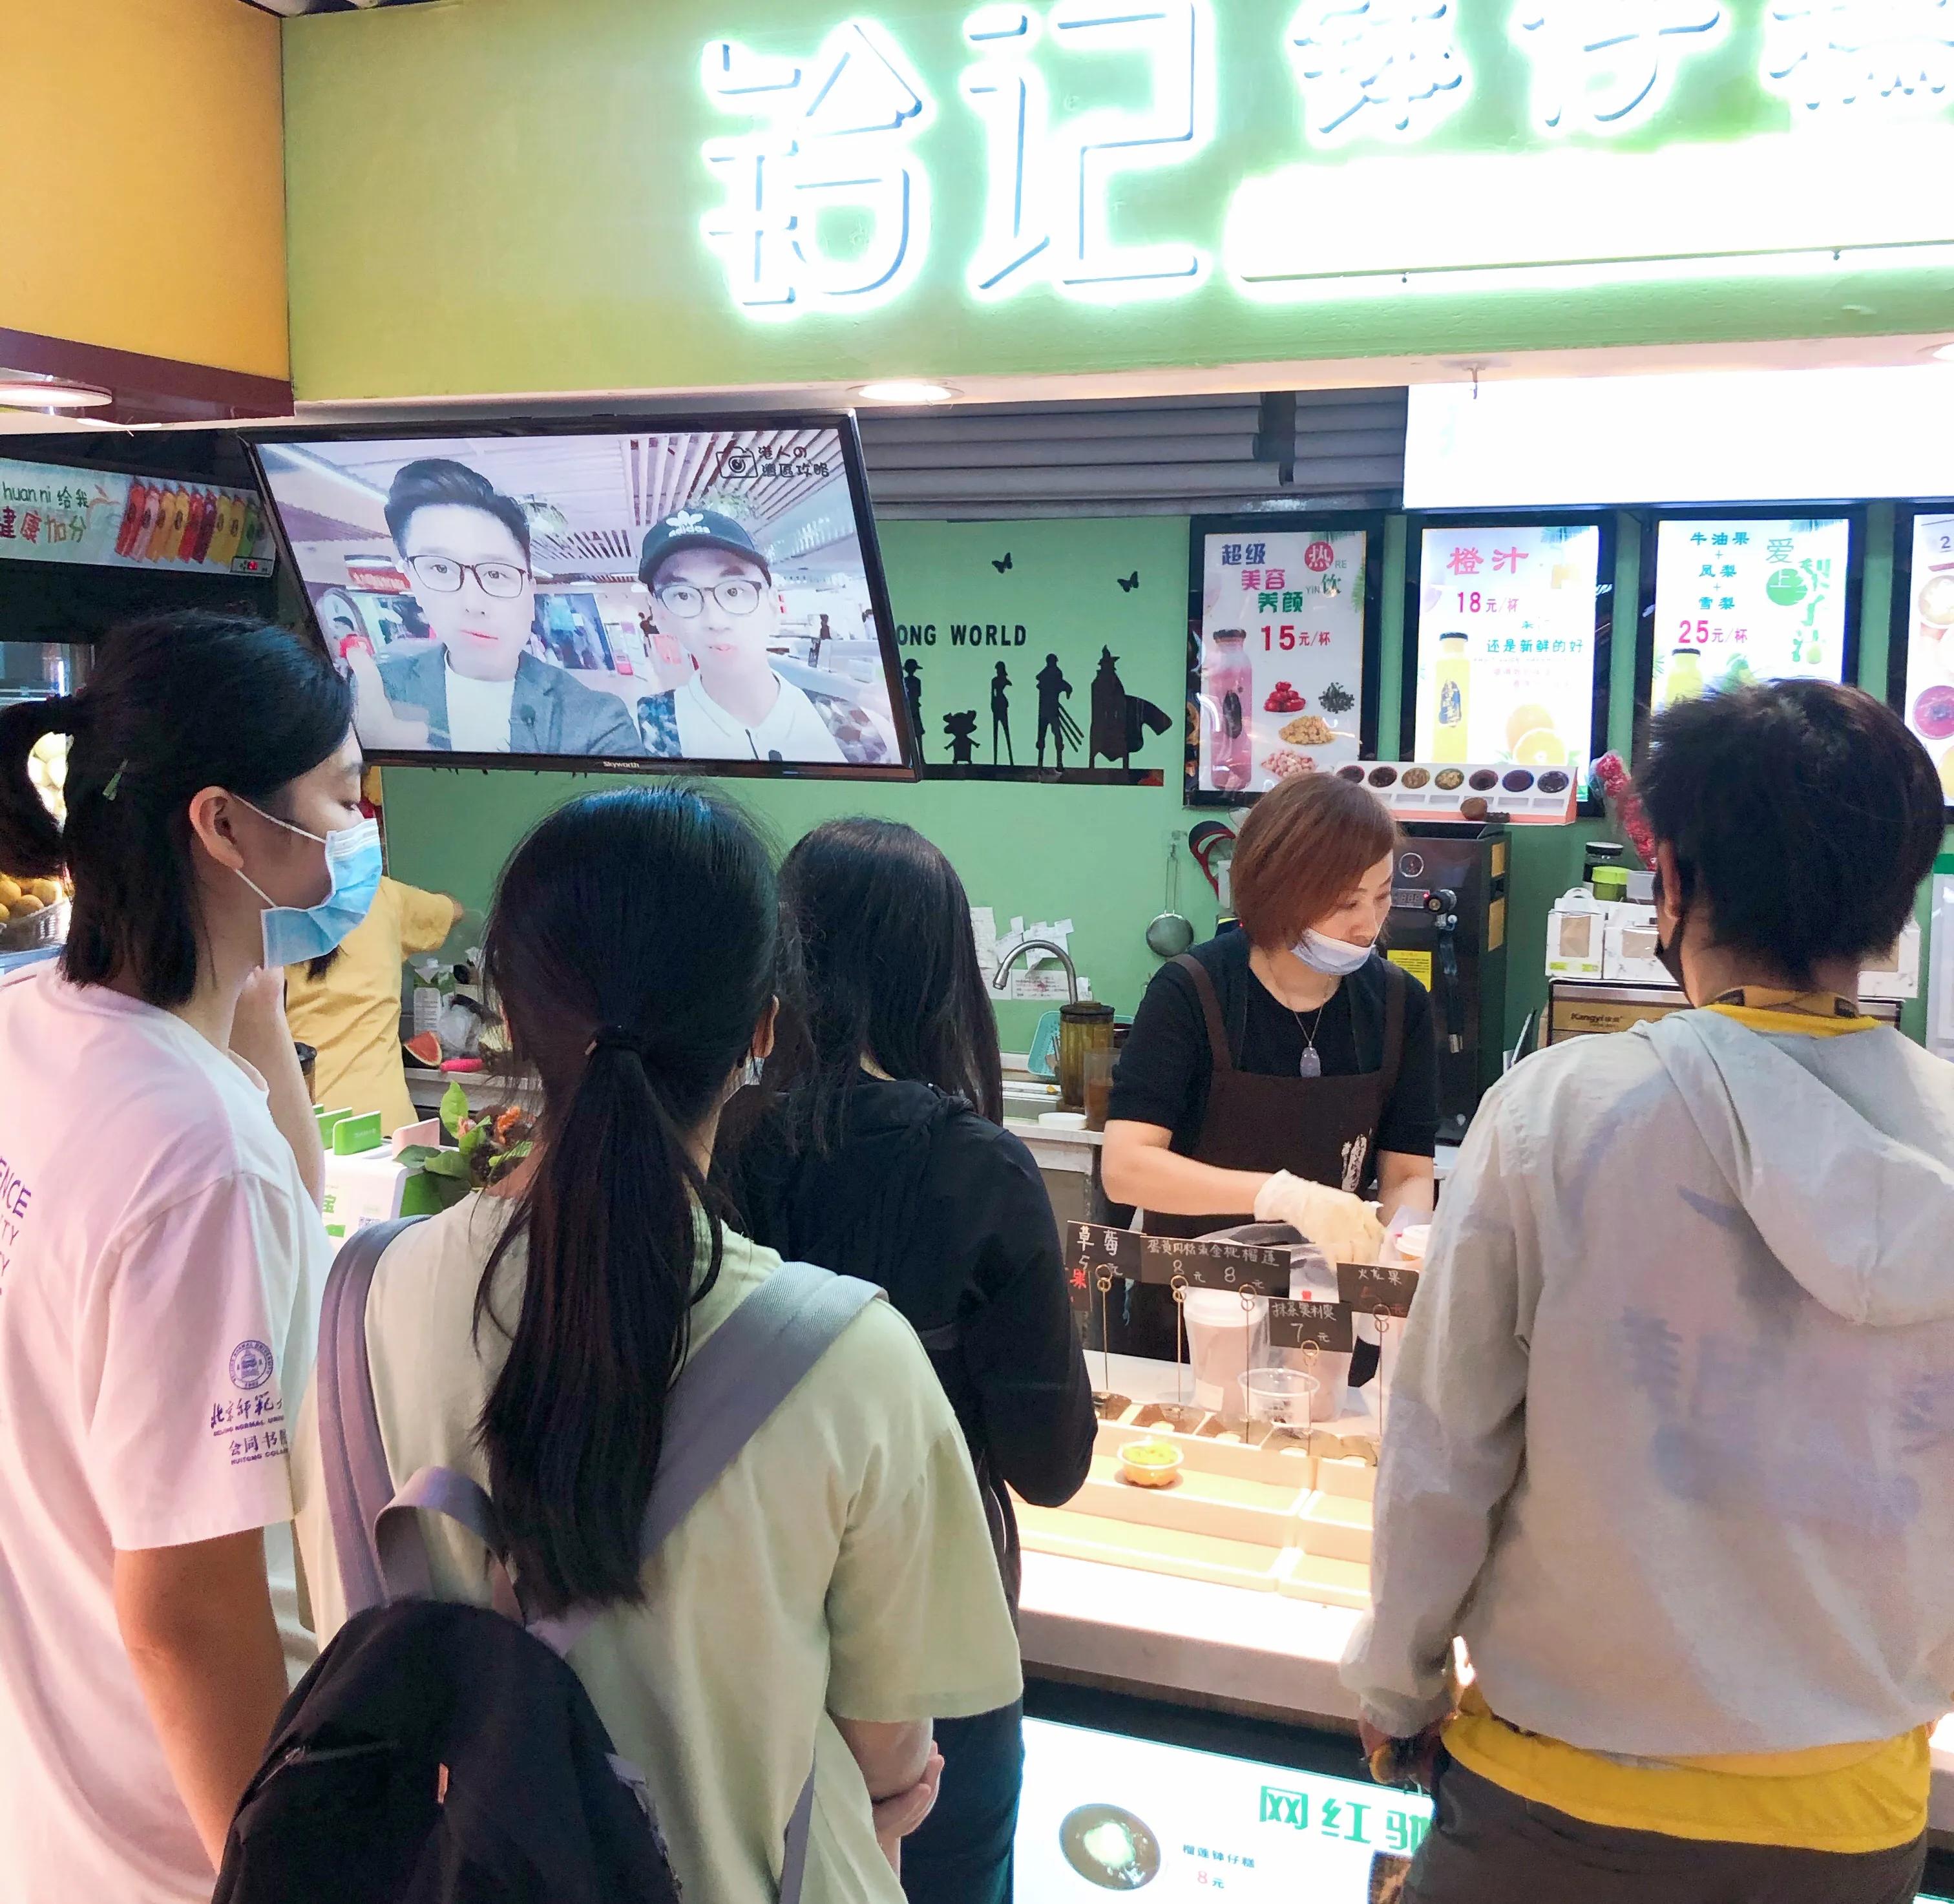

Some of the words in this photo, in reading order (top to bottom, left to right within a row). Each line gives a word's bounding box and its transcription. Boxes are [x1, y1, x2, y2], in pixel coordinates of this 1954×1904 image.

[1690, 532, 1750, 545] 牛油果
[1221, 543, 1266, 565] 超级
[1306, 543, 1332, 570] 热
[1334, 559, 1347, 569] RE
[1446, 547, 1529, 576] 橙汁
[1241, 569, 1286, 591] 美容
[1698, 564, 1737, 578] 凤梨
[1306, 585, 1320, 594] YIN
[1257, 592, 1303, 614] 养颜
[1698, 596, 1736, 611] 雪梨
[951, 624, 1027, 647] WORLD
[1486, 638, 1584, 654] 还是新鲜的好
[1076, 1225, 1119, 1257] 草莓
[1224, 1266, 1236, 1283] 8
[1290, 1323, 1304, 1343] 7
[1317, 1332, 1330, 1343] 元
